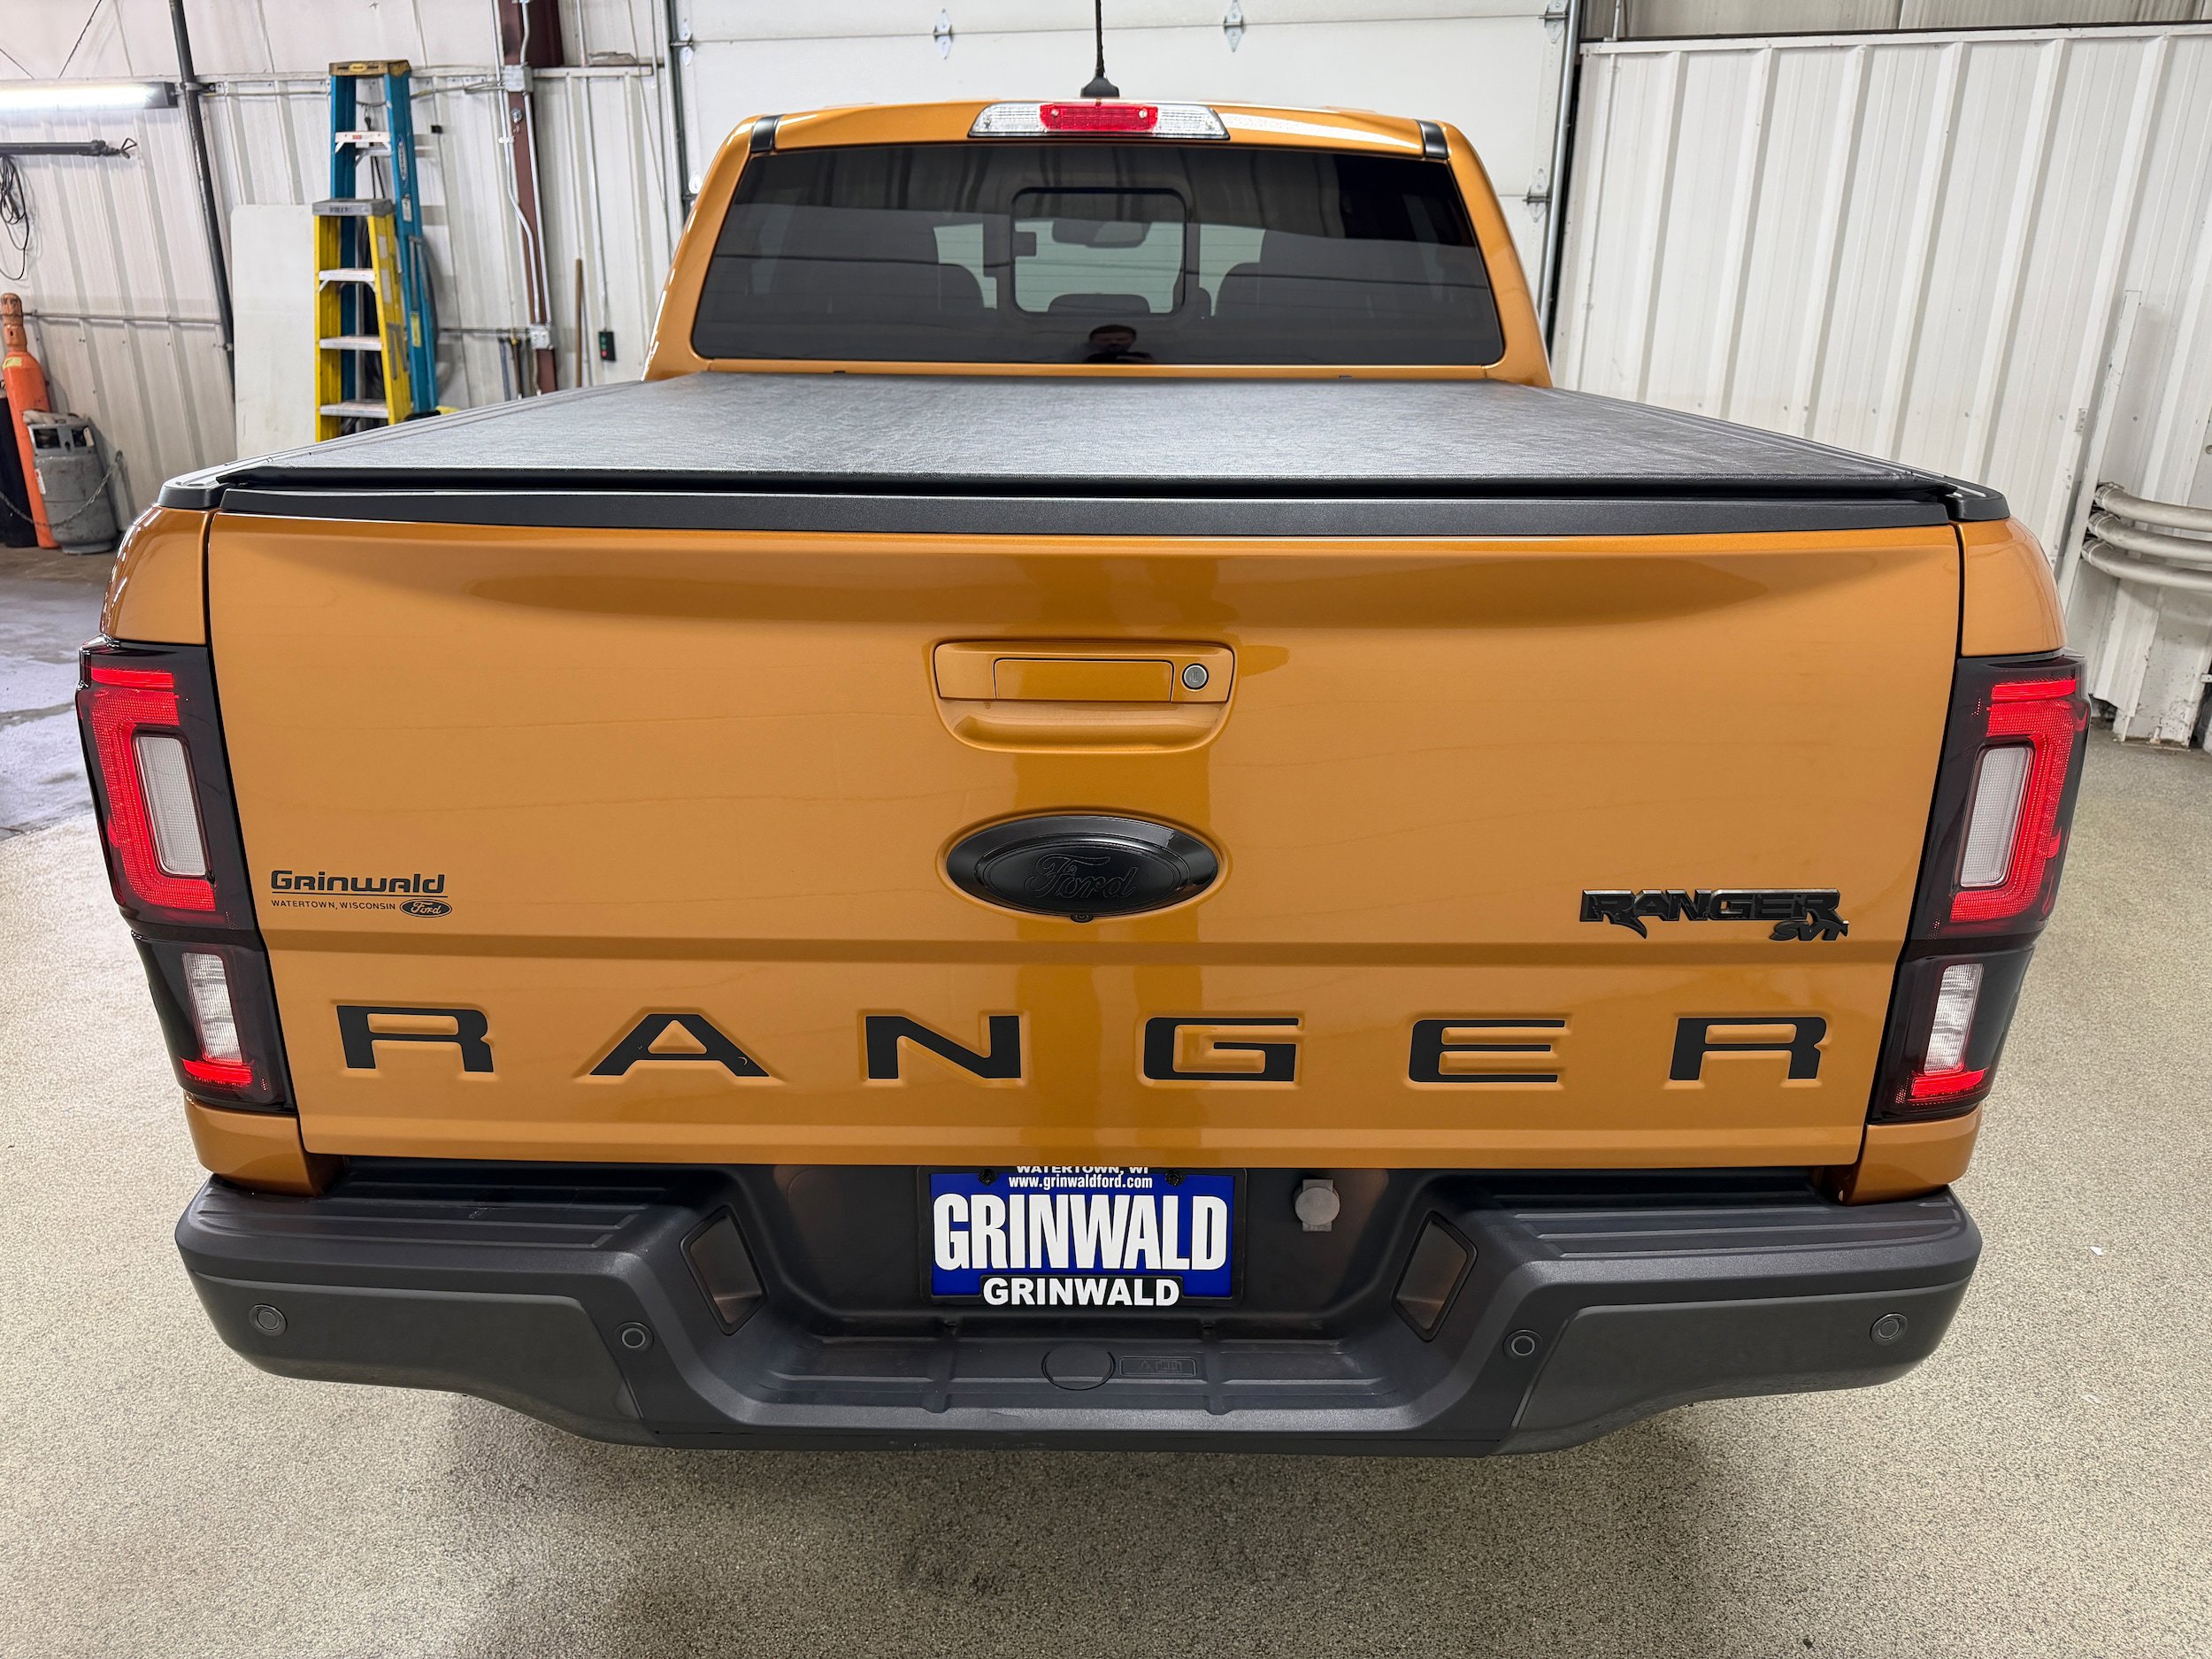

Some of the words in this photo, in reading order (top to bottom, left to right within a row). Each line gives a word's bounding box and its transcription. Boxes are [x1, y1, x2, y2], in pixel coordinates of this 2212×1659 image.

[271, 870, 446, 894] Grinwald
[1024, 852, 1140, 899] Ford
[271, 899, 338, 910] WATERTOWN,
[339, 901, 396, 910] WISCONSIN
[411, 900, 442, 915] Ford
[1579, 888, 1841, 939] RANGER
[336, 1005, 1827, 1082] RANGER
[1009, 1174, 1153, 1190] www.grinwaldford.com
[933, 1193, 1228, 1271] GRINWALD
[983, 1277, 1180, 1307] GRINWALD
